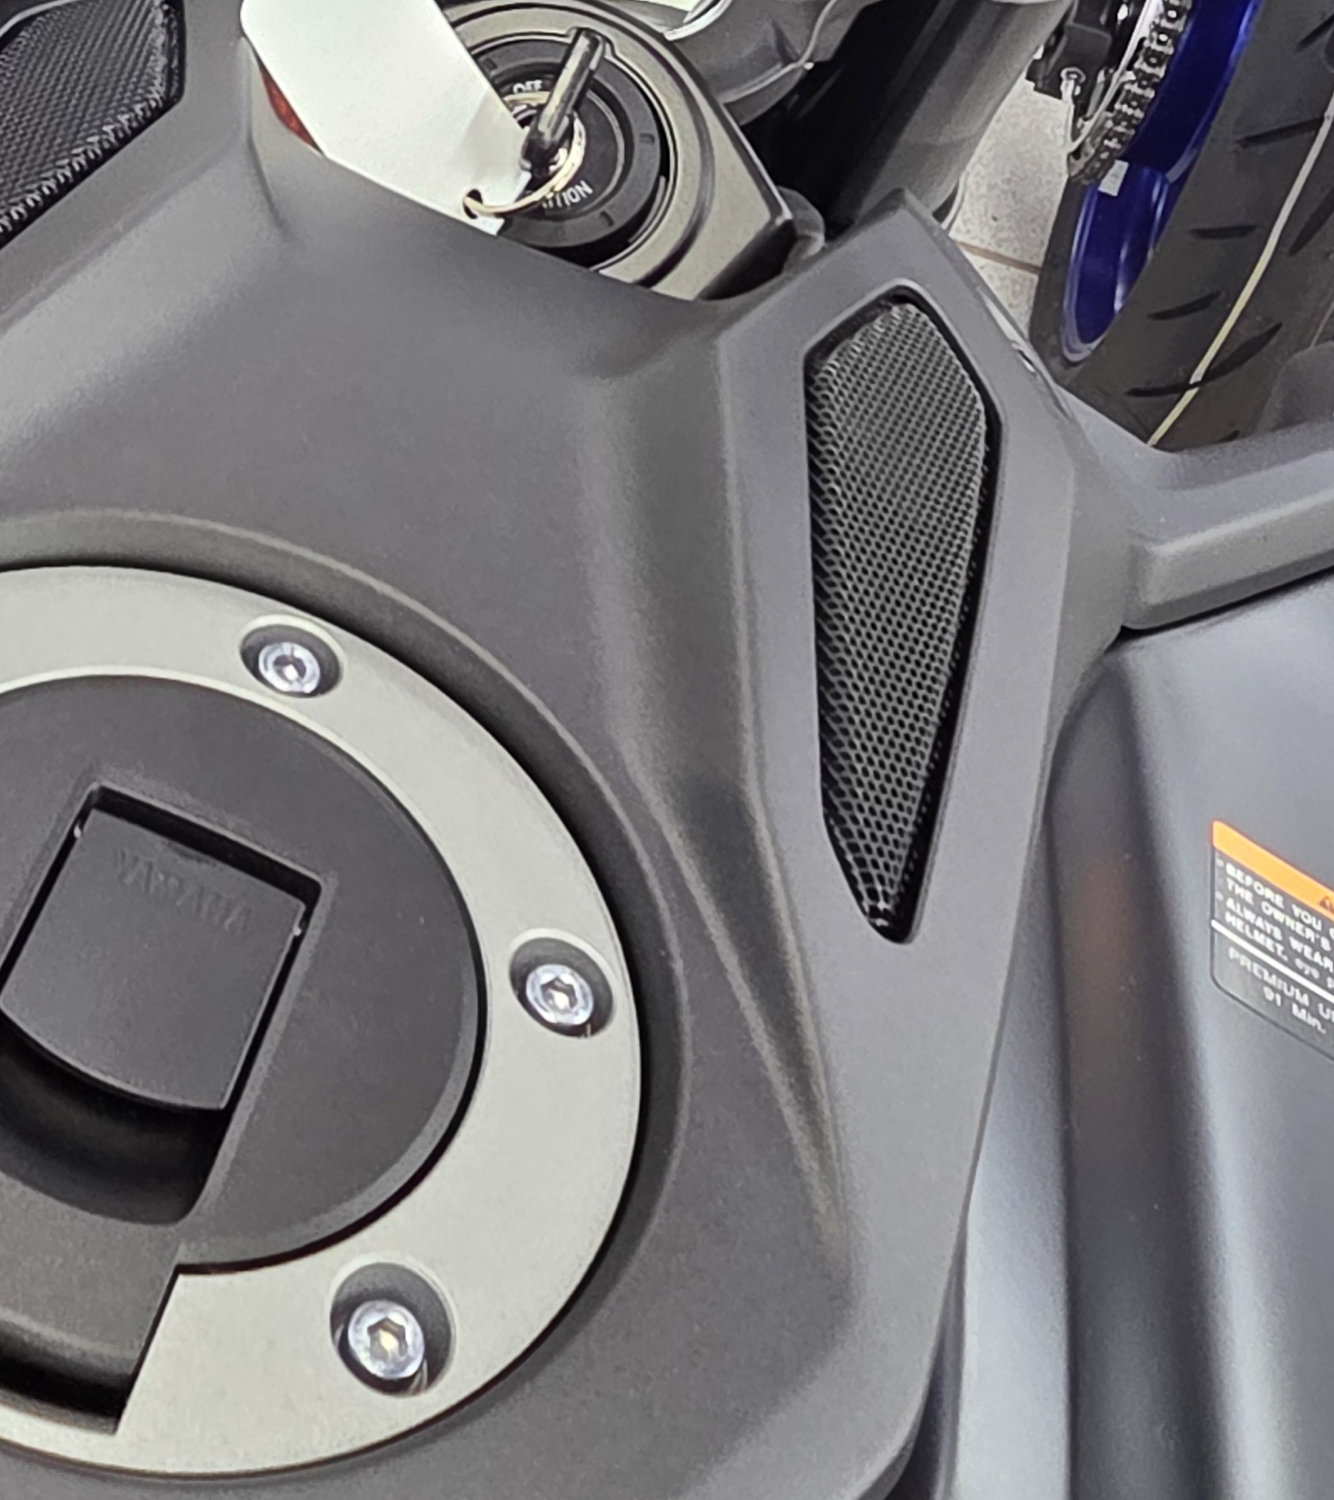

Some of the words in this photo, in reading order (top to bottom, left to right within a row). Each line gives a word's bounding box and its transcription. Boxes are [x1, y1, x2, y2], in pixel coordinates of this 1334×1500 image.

[1226, 862, 1283, 909] BEFORE
[1292, 903, 1321, 932] YOU
[1226, 876, 1253, 906] THE
[1261, 898, 1331, 953] OWNER'S
[1226, 895, 1281, 941] ALWAYS
[1289, 934, 1333, 973] WEAR
[1228, 945, 1309, 1009] PREMIUM
[1263, 983, 1281, 1007] 91
[1293, 1001, 1326, 1035] Min.
